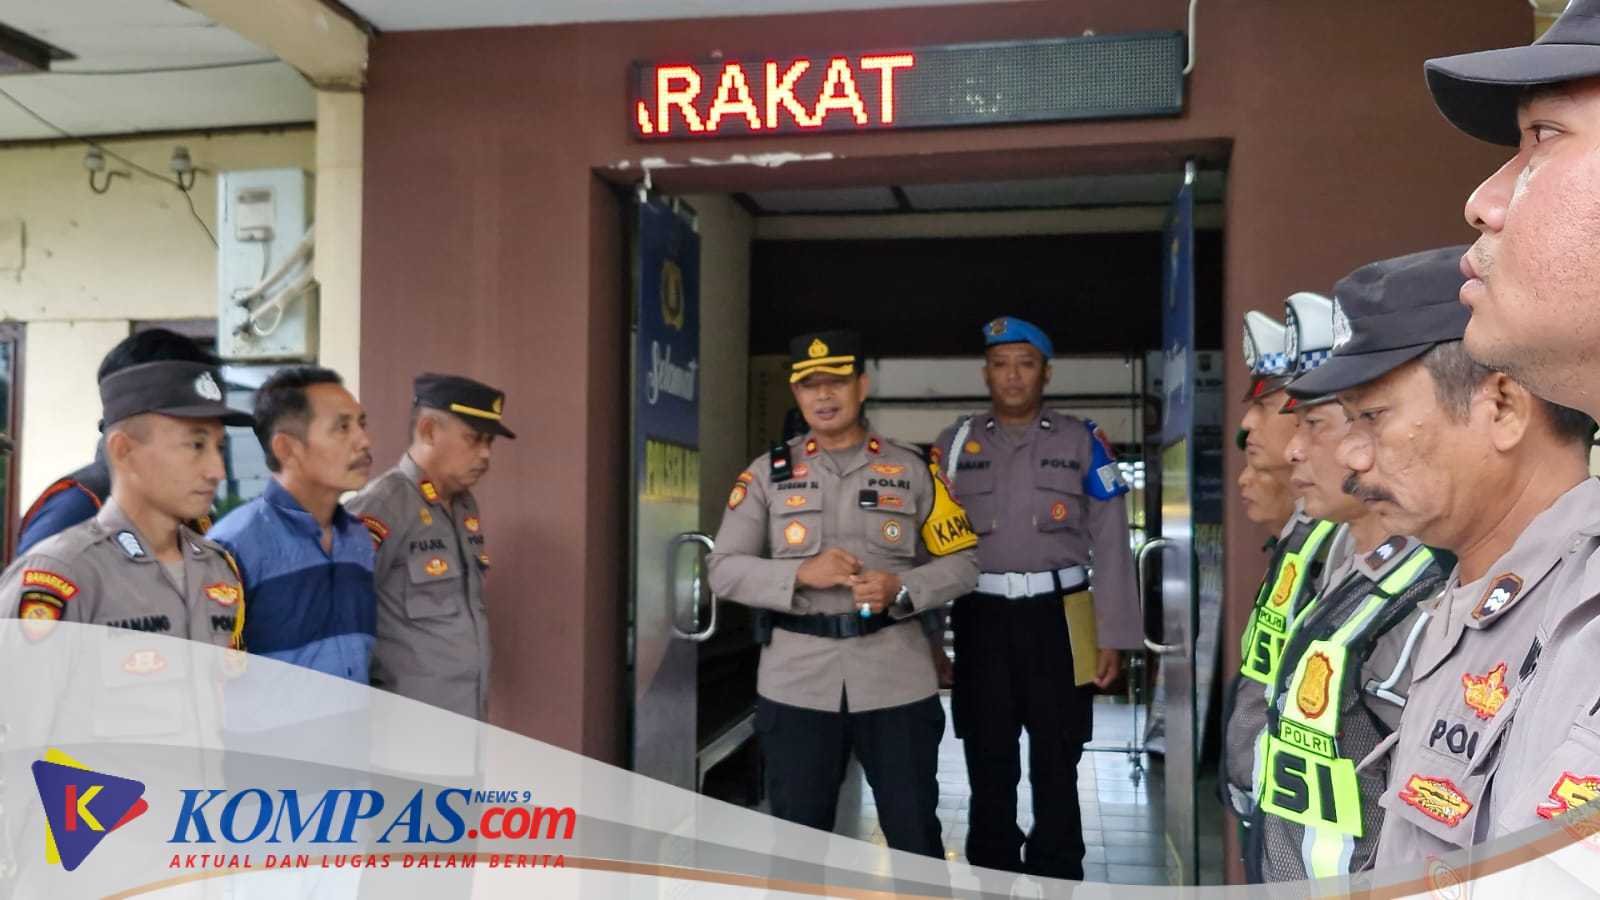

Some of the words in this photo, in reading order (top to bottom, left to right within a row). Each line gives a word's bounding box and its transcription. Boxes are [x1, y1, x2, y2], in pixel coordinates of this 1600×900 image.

[868, 477, 911, 490] POLRI
[1259, 611, 1282, 628] POLRI
[1284, 727, 1329, 754] POLRI
